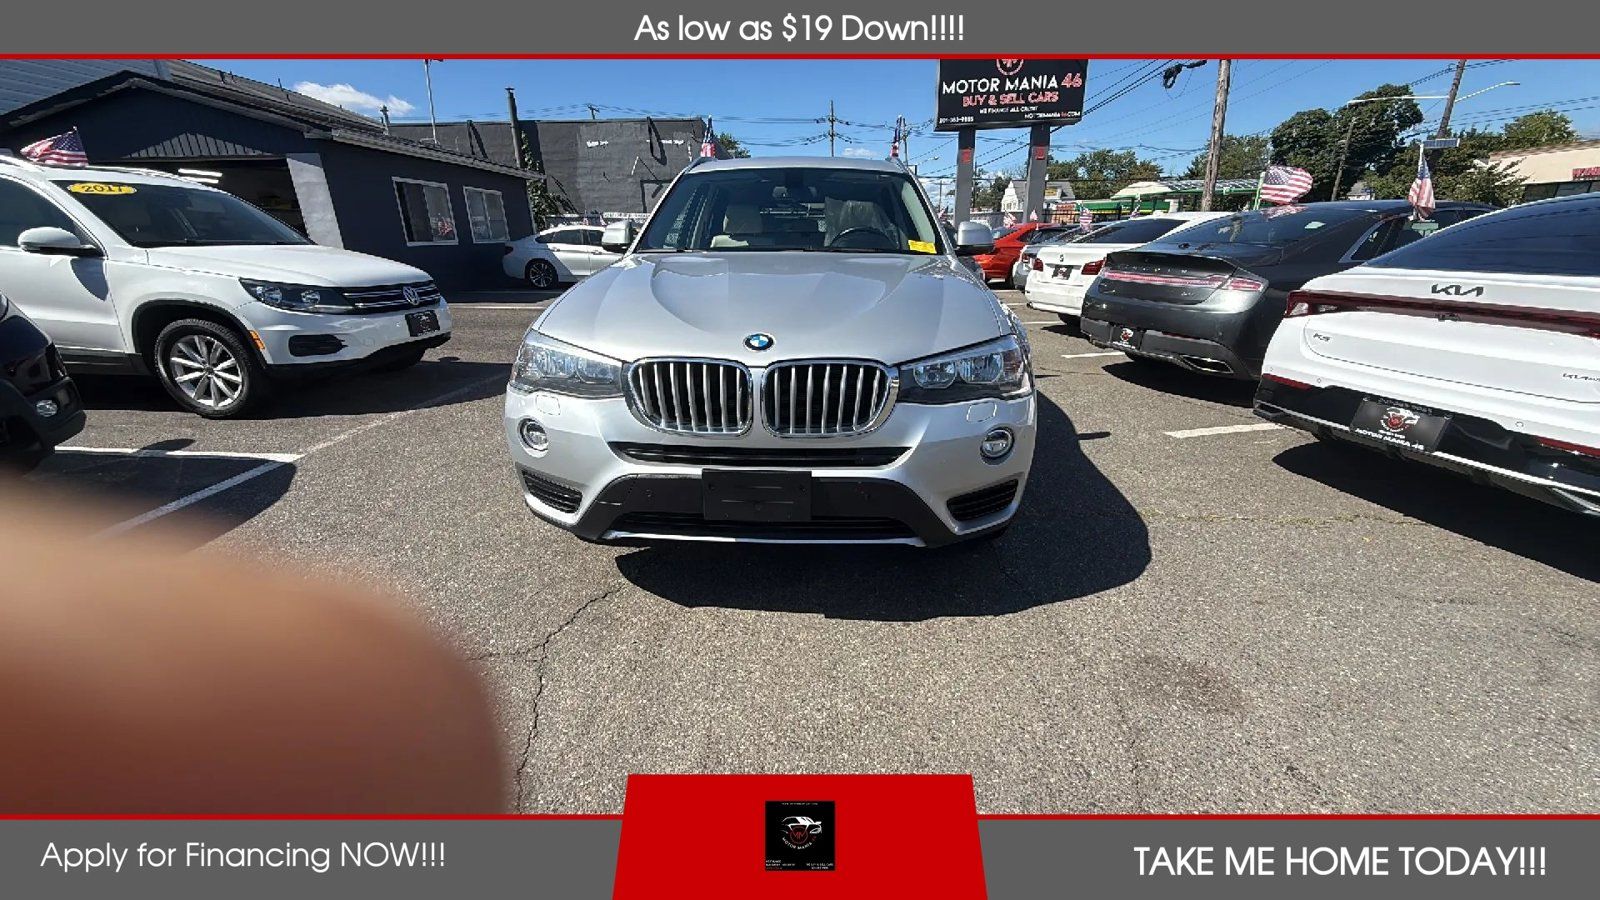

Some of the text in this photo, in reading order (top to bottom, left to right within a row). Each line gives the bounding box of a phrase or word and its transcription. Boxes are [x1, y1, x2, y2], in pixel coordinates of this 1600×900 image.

[942, 72, 1083, 94] MOTOR MANIA 46
[962, 91, 1059, 107] BUY & SELL CARS
[1431, 283, 1484, 297] KIA
